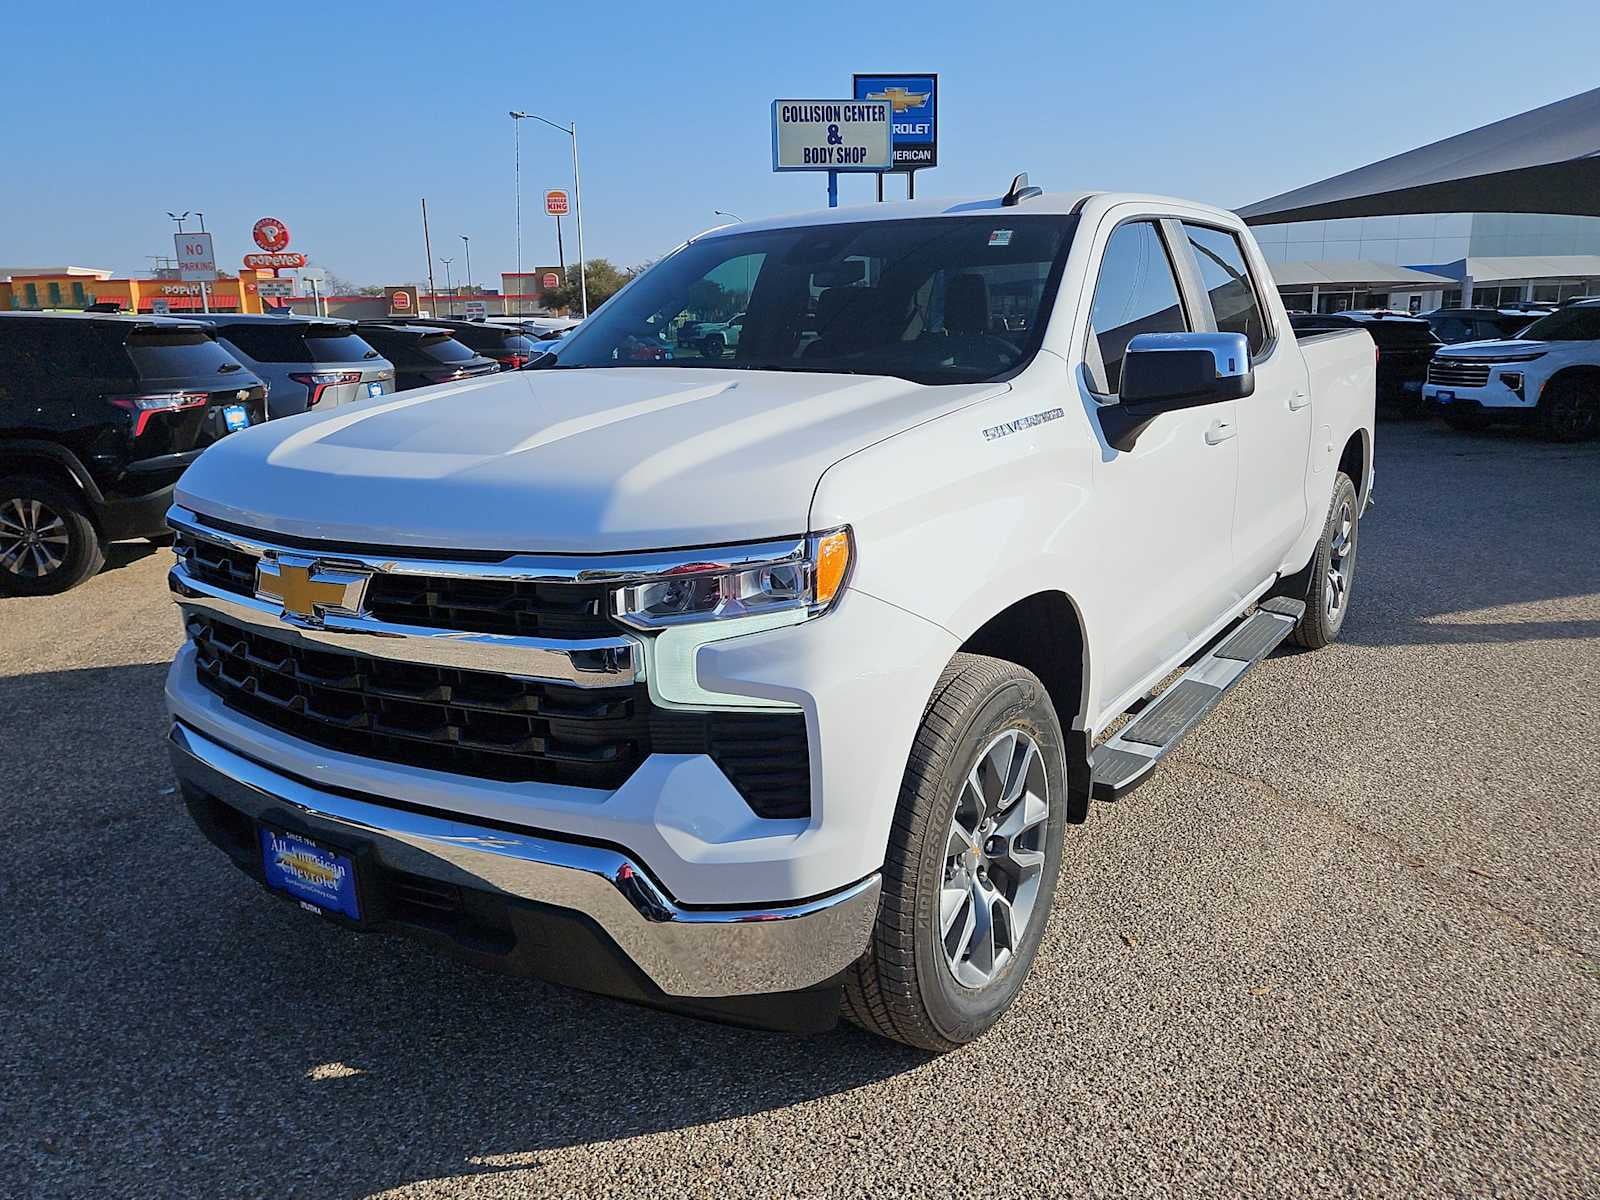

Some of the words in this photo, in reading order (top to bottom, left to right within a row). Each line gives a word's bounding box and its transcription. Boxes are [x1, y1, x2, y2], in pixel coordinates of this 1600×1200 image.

[782, 105, 841, 123] COLLISION
[844, 104, 886, 122] CENTER
[826, 124, 842, 145] &
[803, 147, 834, 164] BODY
[836, 147, 867, 164] SHOP
[185, 244, 204, 256] NO
[180, 261, 214, 272] PARKING
[164, 284, 212, 295] POPYS
[271, 839, 287, 852] All
[281, 859, 339, 891] Chevrolet
